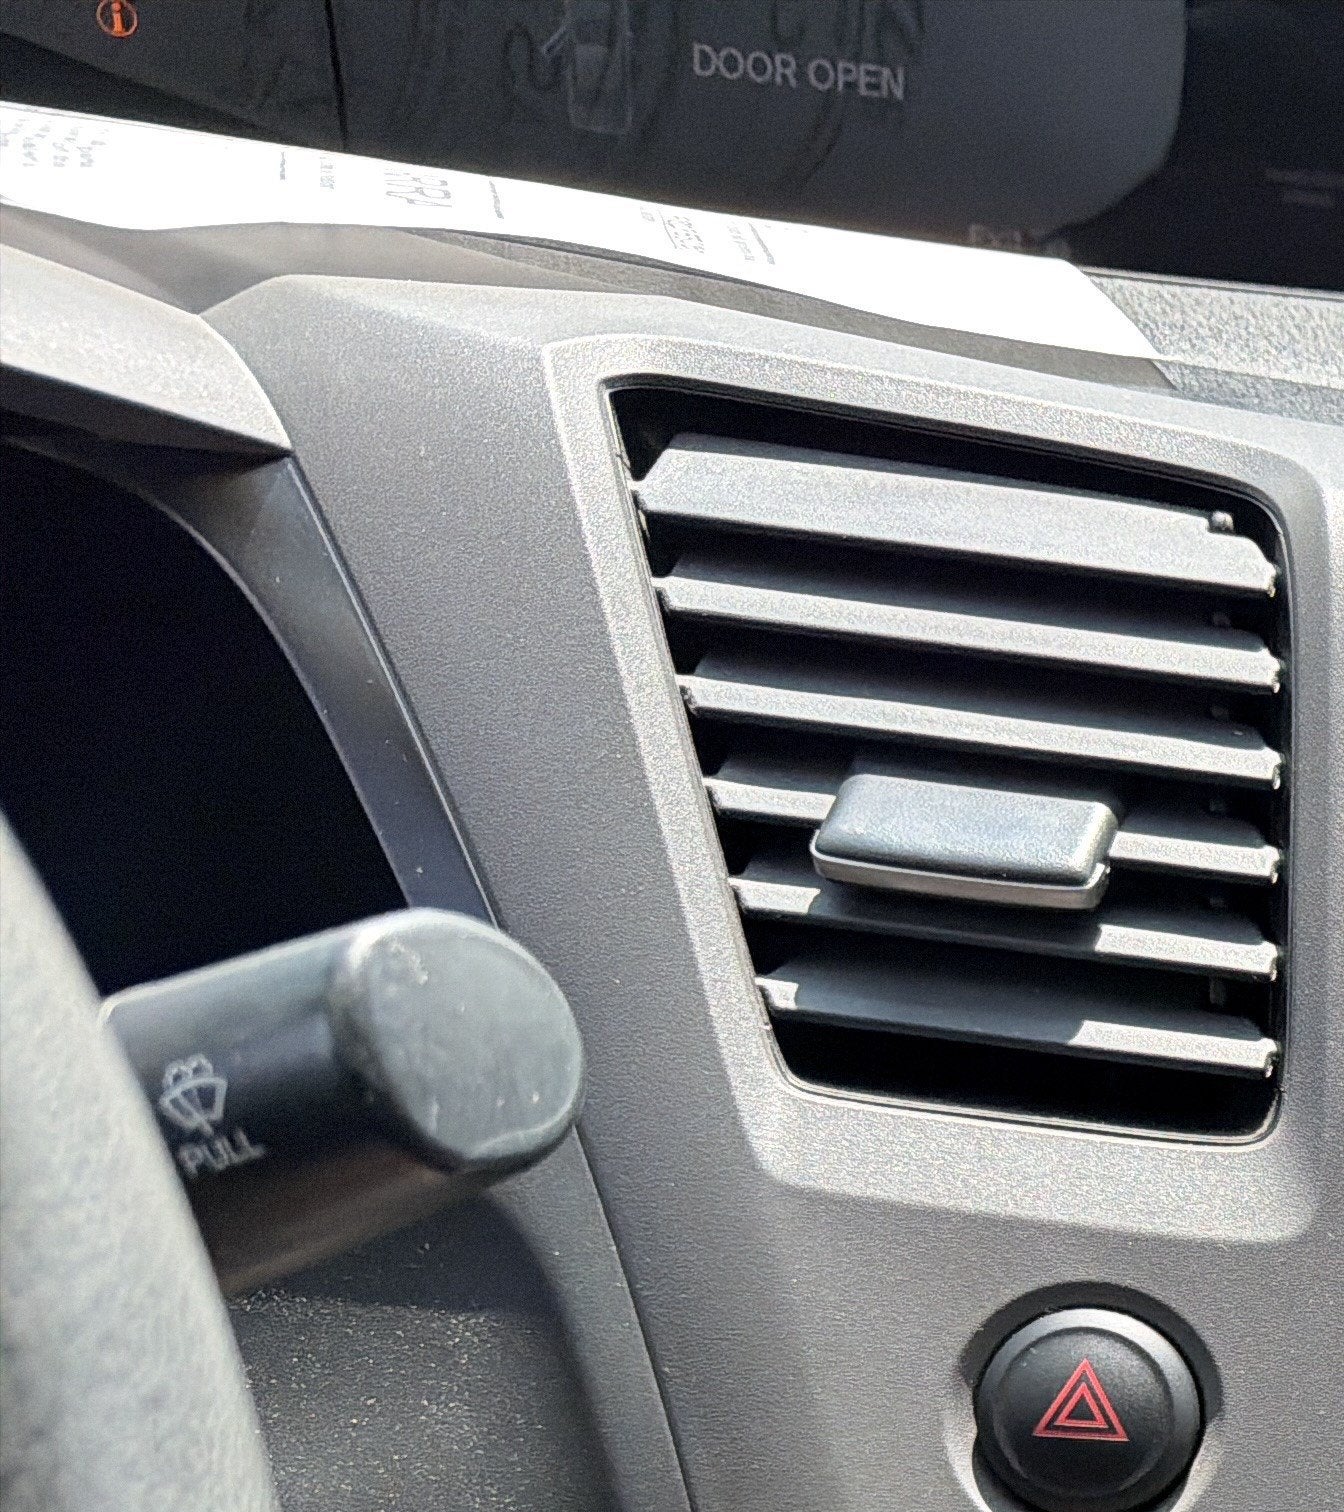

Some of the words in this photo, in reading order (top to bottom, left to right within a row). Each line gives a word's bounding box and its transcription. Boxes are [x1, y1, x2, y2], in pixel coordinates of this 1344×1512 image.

[692, 41, 798, 88] DOOR
[806, 58, 905, 100] OPEN
[176, 1128, 267, 1178] PULL
